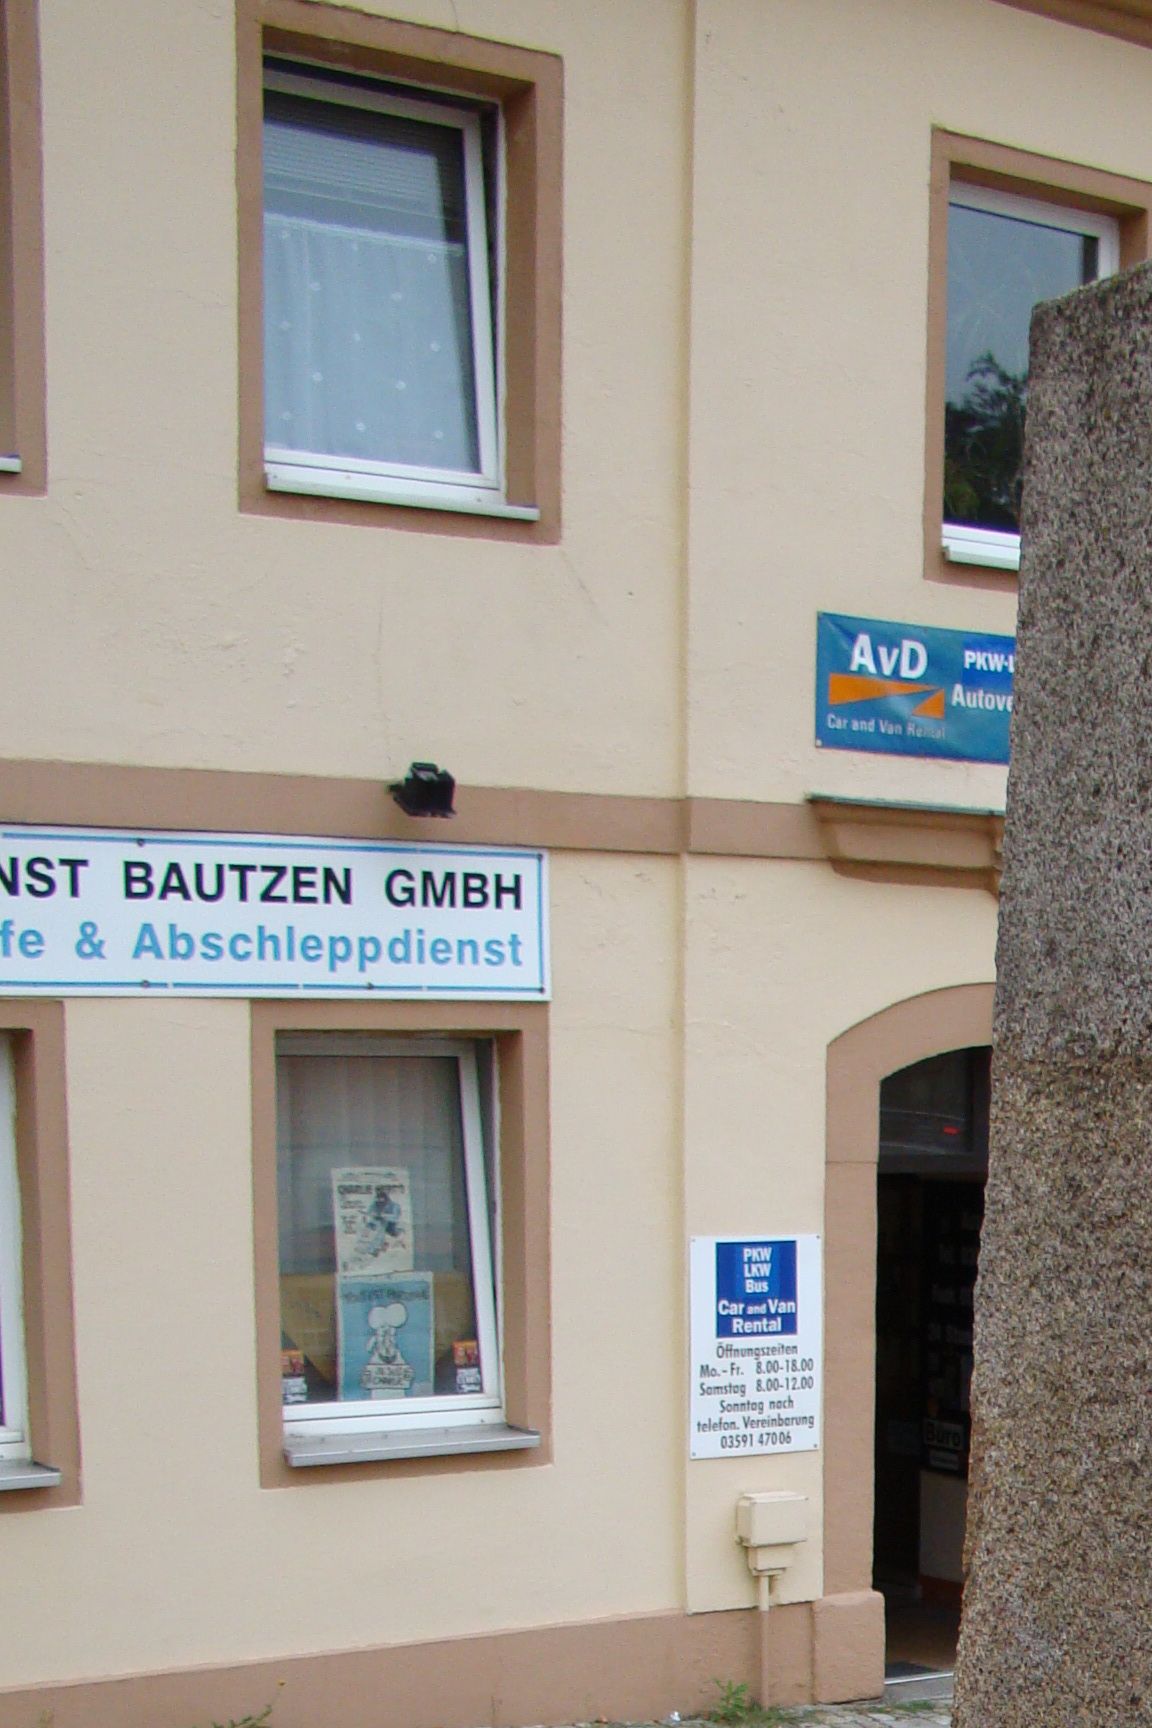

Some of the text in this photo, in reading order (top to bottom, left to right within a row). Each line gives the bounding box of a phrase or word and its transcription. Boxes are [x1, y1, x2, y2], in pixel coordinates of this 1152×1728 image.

[850, 633, 928, 680] AvD
[827, 712, 848, 730] Car
[852, 719, 875, 733] and
[879, 719, 902, 735] Van
[123, 860, 353, 905] BAUTZEN
[384, 868, 523, 912] GMBH
[75, 920, 107, 960] &
[131, 921, 523, 974] Abschleppdienst
[743, 1246, 772, 1262] PKW
[743, 1263, 772, 1278] LKW
[745, 1279, 769, 1293] Bus
[718, 1298, 796, 1315] Car and Van
[732, 1317, 782, 1333] Rental
[716, 1342, 798, 1361] Öffnungszeiten
[756, 1358, 814, 1375] 8.00-18.00
[699, 1376, 814, 1397] Samstag 8.00-12.00
[720, 1395, 794, 1415] Sonntag nach
[697, 1413, 815, 1433] telefon. Vereinbarung
[720, 1433, 753, 1449] 03591
